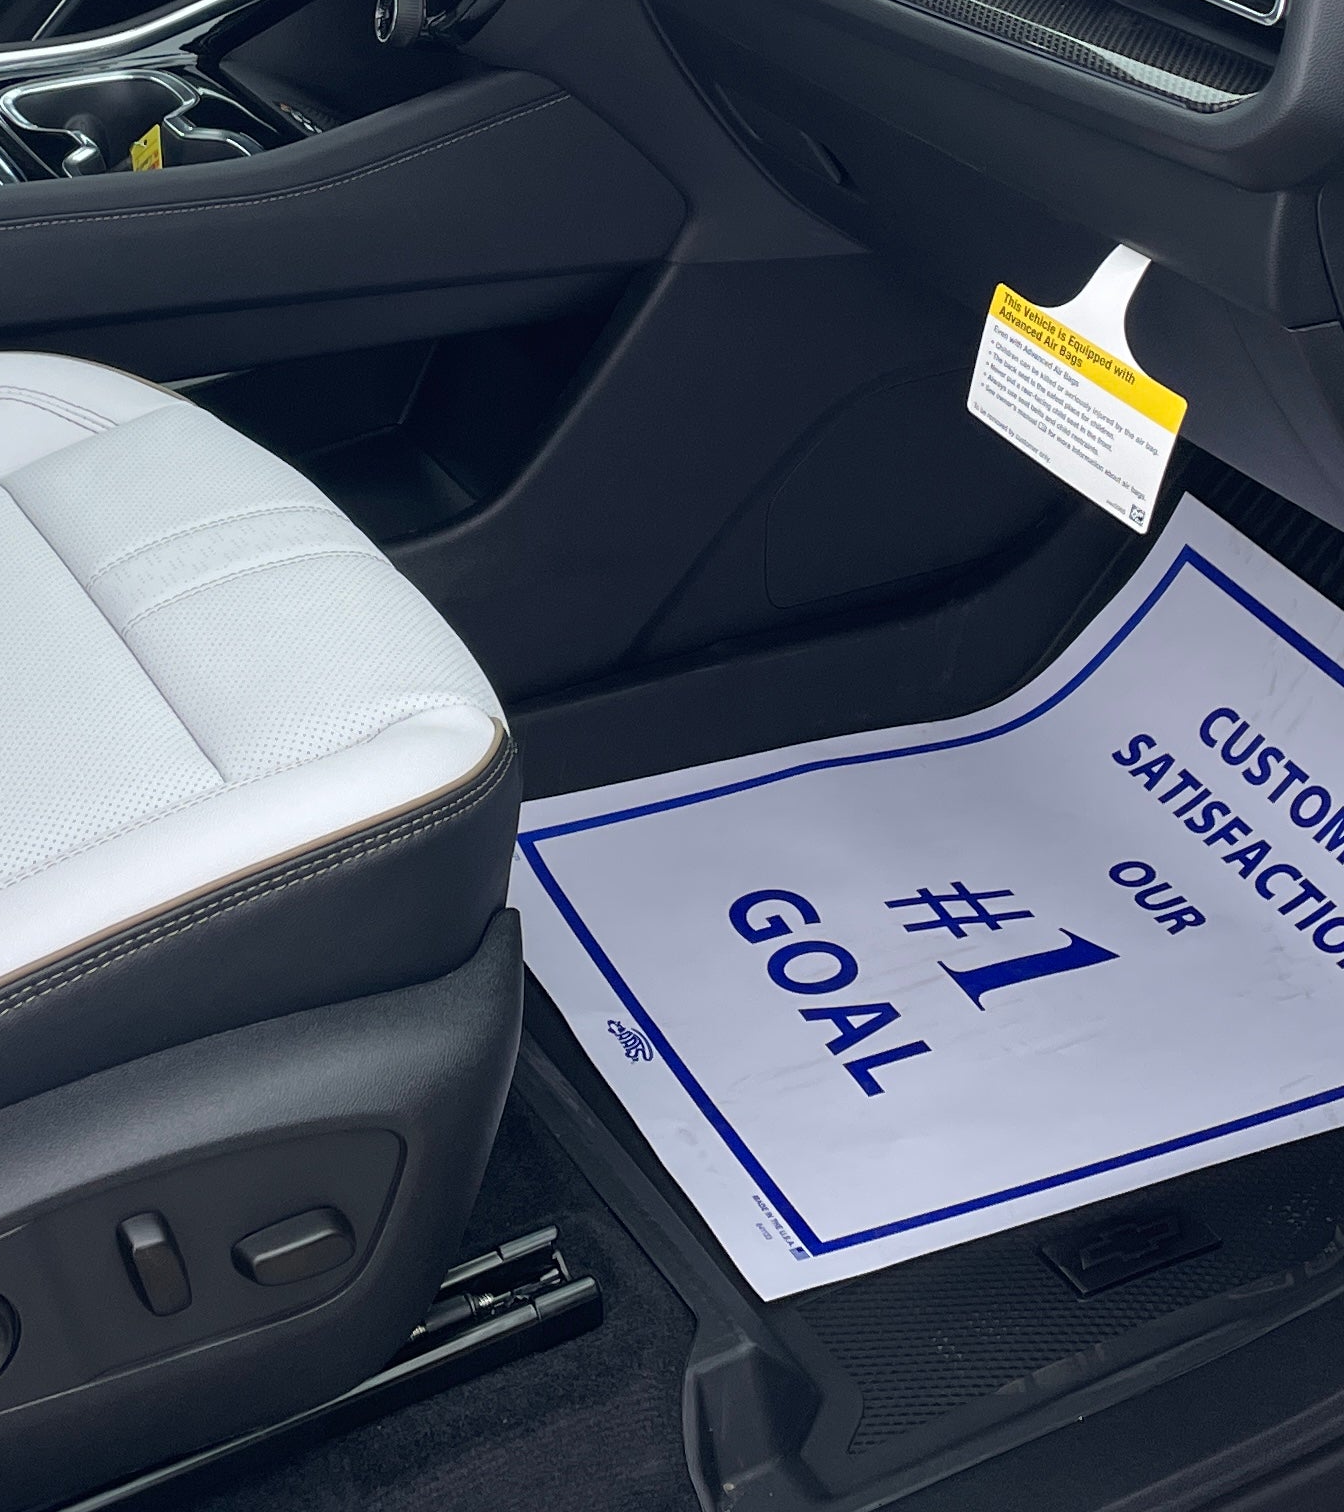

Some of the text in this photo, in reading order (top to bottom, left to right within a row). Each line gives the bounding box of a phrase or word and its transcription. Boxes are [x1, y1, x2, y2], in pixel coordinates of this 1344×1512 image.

[993, 324, 1079, 388] Even with Advanced Air Bags
[999, 304, 1083, 370] Advanced Air Bags
[1003, 292, 1022, 312] This
[1023, 305, 1056, 335] Vehicle
[1067, 334, 1112, 372] Equipped
[1113, 362, 1136, 385] with
[992, 351, 1003, 364] The
[1004, 360, 1016, 373] back
[1036, 382, 1046, 393] the
[1080, 412, 1089, 423] for
[995, 341, 1018, 362] Children
[1019, 358, 1031, 370] can
[1031, 366, 1039, 376] be
[1040, 372, 1056, 387] killed
[1057, 384, 1064, 392] or
[1064, 389, 1091, 412] seriously
[1092, 407, 1114, 427] injured
[1114, 421, 1123, 433] by
[1123, 428, 1135, 440] the
[1135, 435, 1144, 446] air
[1052, 406, 1066, 420] child
[1079, 424, 1086, 433] in
[1044, 414, 1055, 426] and
[1056, 422, 1070, 436] child
[1108, 861, 1207, 935] OUR
[884, 882, 1121, 1011] #1
[729, 889, 932, 1097] GOAL
[752, 1194, 769, 1211] MADE
